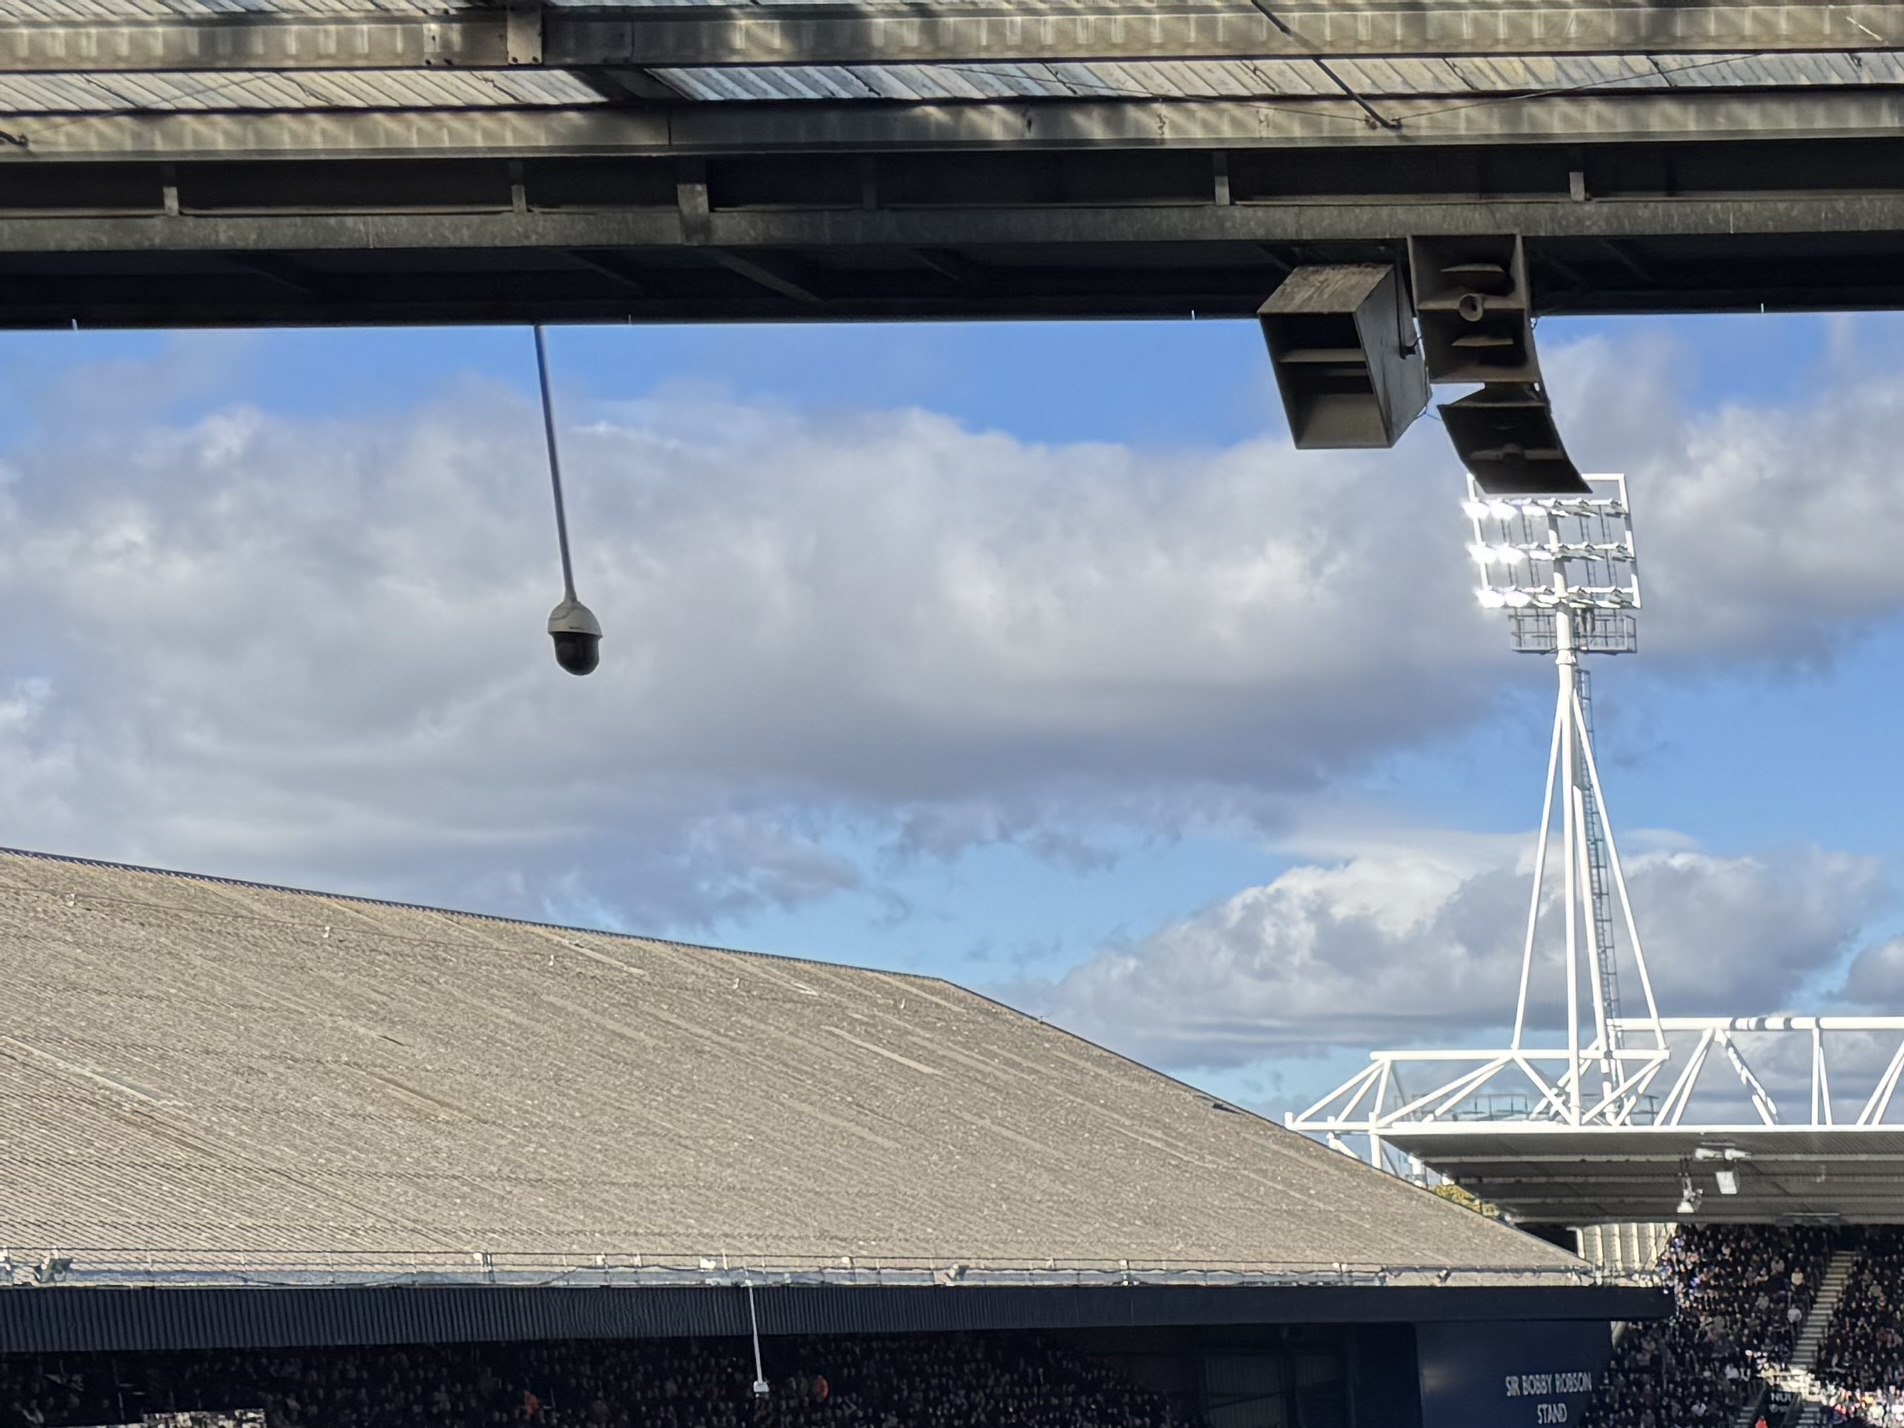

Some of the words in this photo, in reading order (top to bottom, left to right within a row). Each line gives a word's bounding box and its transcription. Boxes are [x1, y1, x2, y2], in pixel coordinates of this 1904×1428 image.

[1505, 1376, 1520, 1397] SIR
[1522, 1374, 1551, 1395] BOBBY
[1555, 1372, 1593, 1394] ROBSON
[1537, 1403, 1568, 1424] STAND
